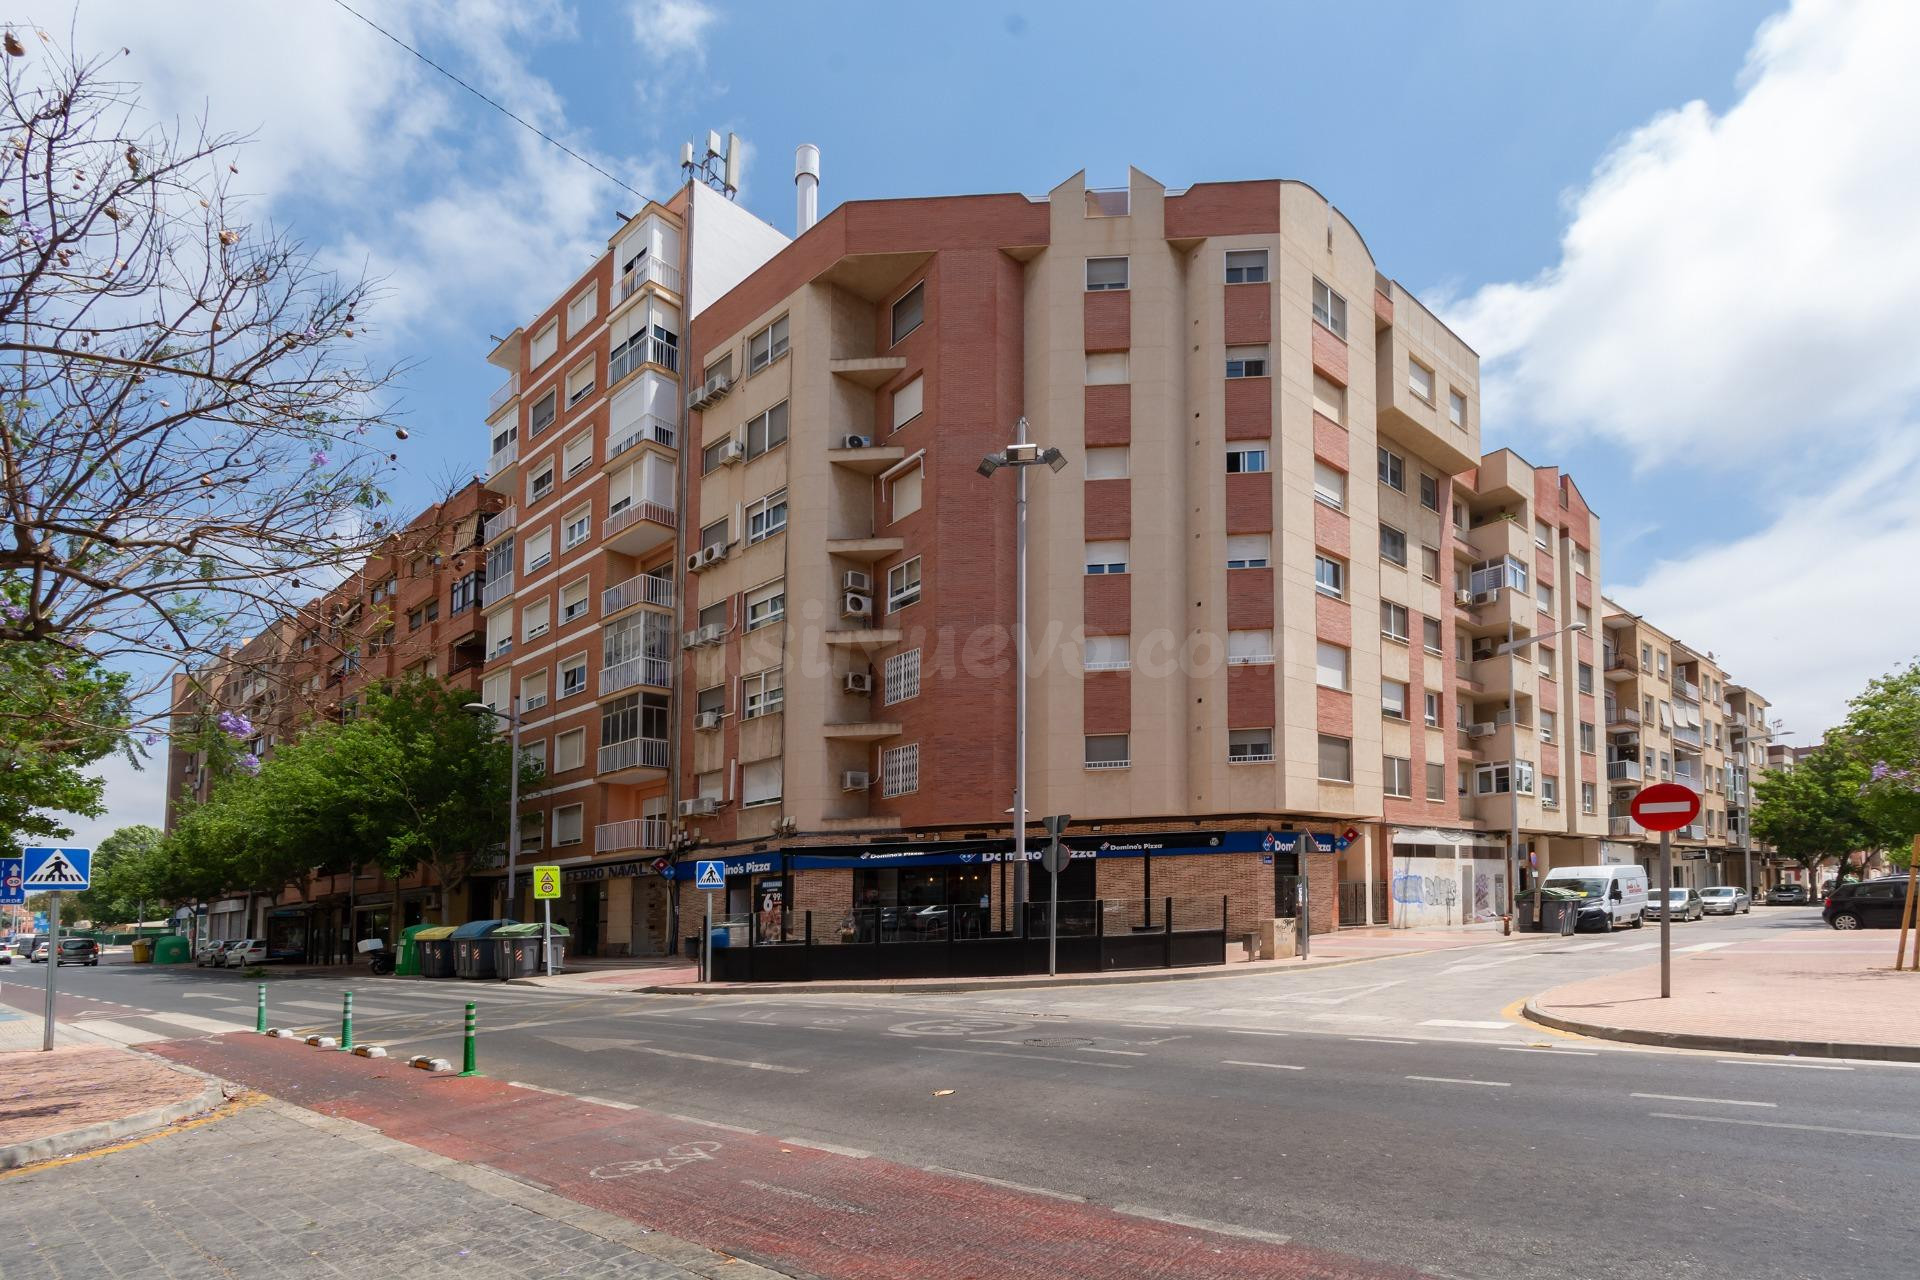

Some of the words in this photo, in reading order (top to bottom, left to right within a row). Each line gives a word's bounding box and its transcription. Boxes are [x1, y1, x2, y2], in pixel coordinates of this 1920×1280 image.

[1110, 843, 1142, 851] Domino's
[1070, 850, 1097, 859] zza
[566, 869, 604, 882] FERRO
[608, 863, 648, 877] NAVAL
[725, 863, 744, 875] ino's
[746, 861, 772, 873] Pizza
